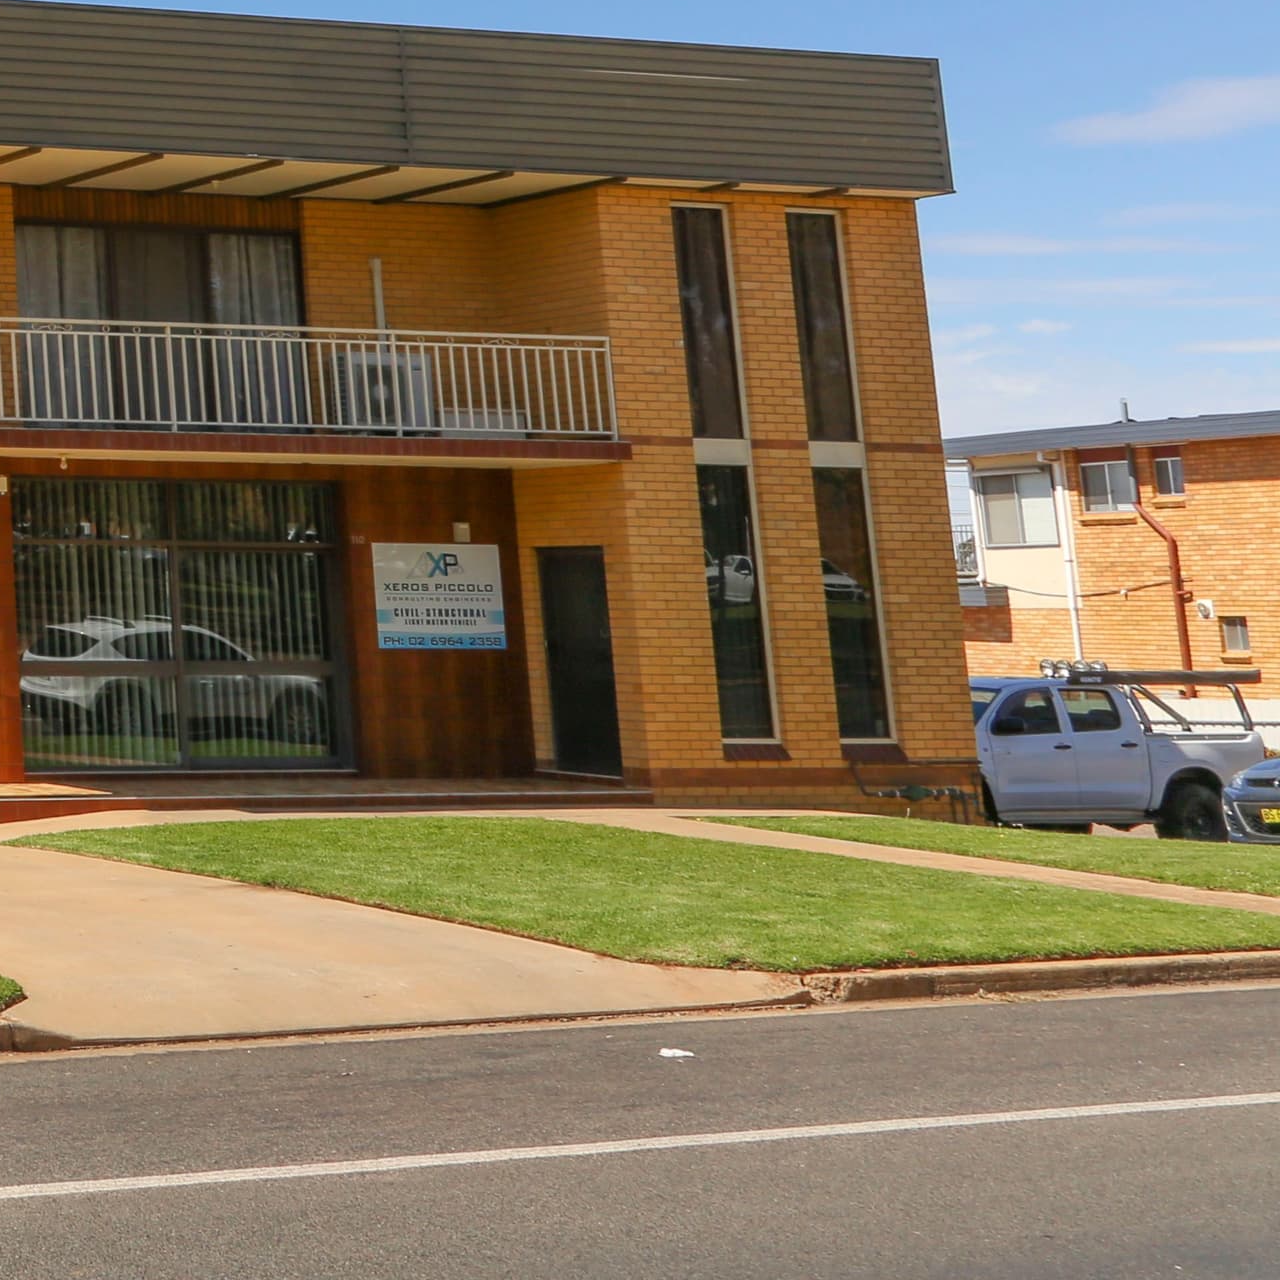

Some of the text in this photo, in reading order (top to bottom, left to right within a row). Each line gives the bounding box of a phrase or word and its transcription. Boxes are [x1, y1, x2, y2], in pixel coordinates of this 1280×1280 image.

[425, 551, 459, 577] XP
[383, 583, 493, 593] XEROS PICCOLO
[383, 636, 501, 647] PH: 02 6964 2358
